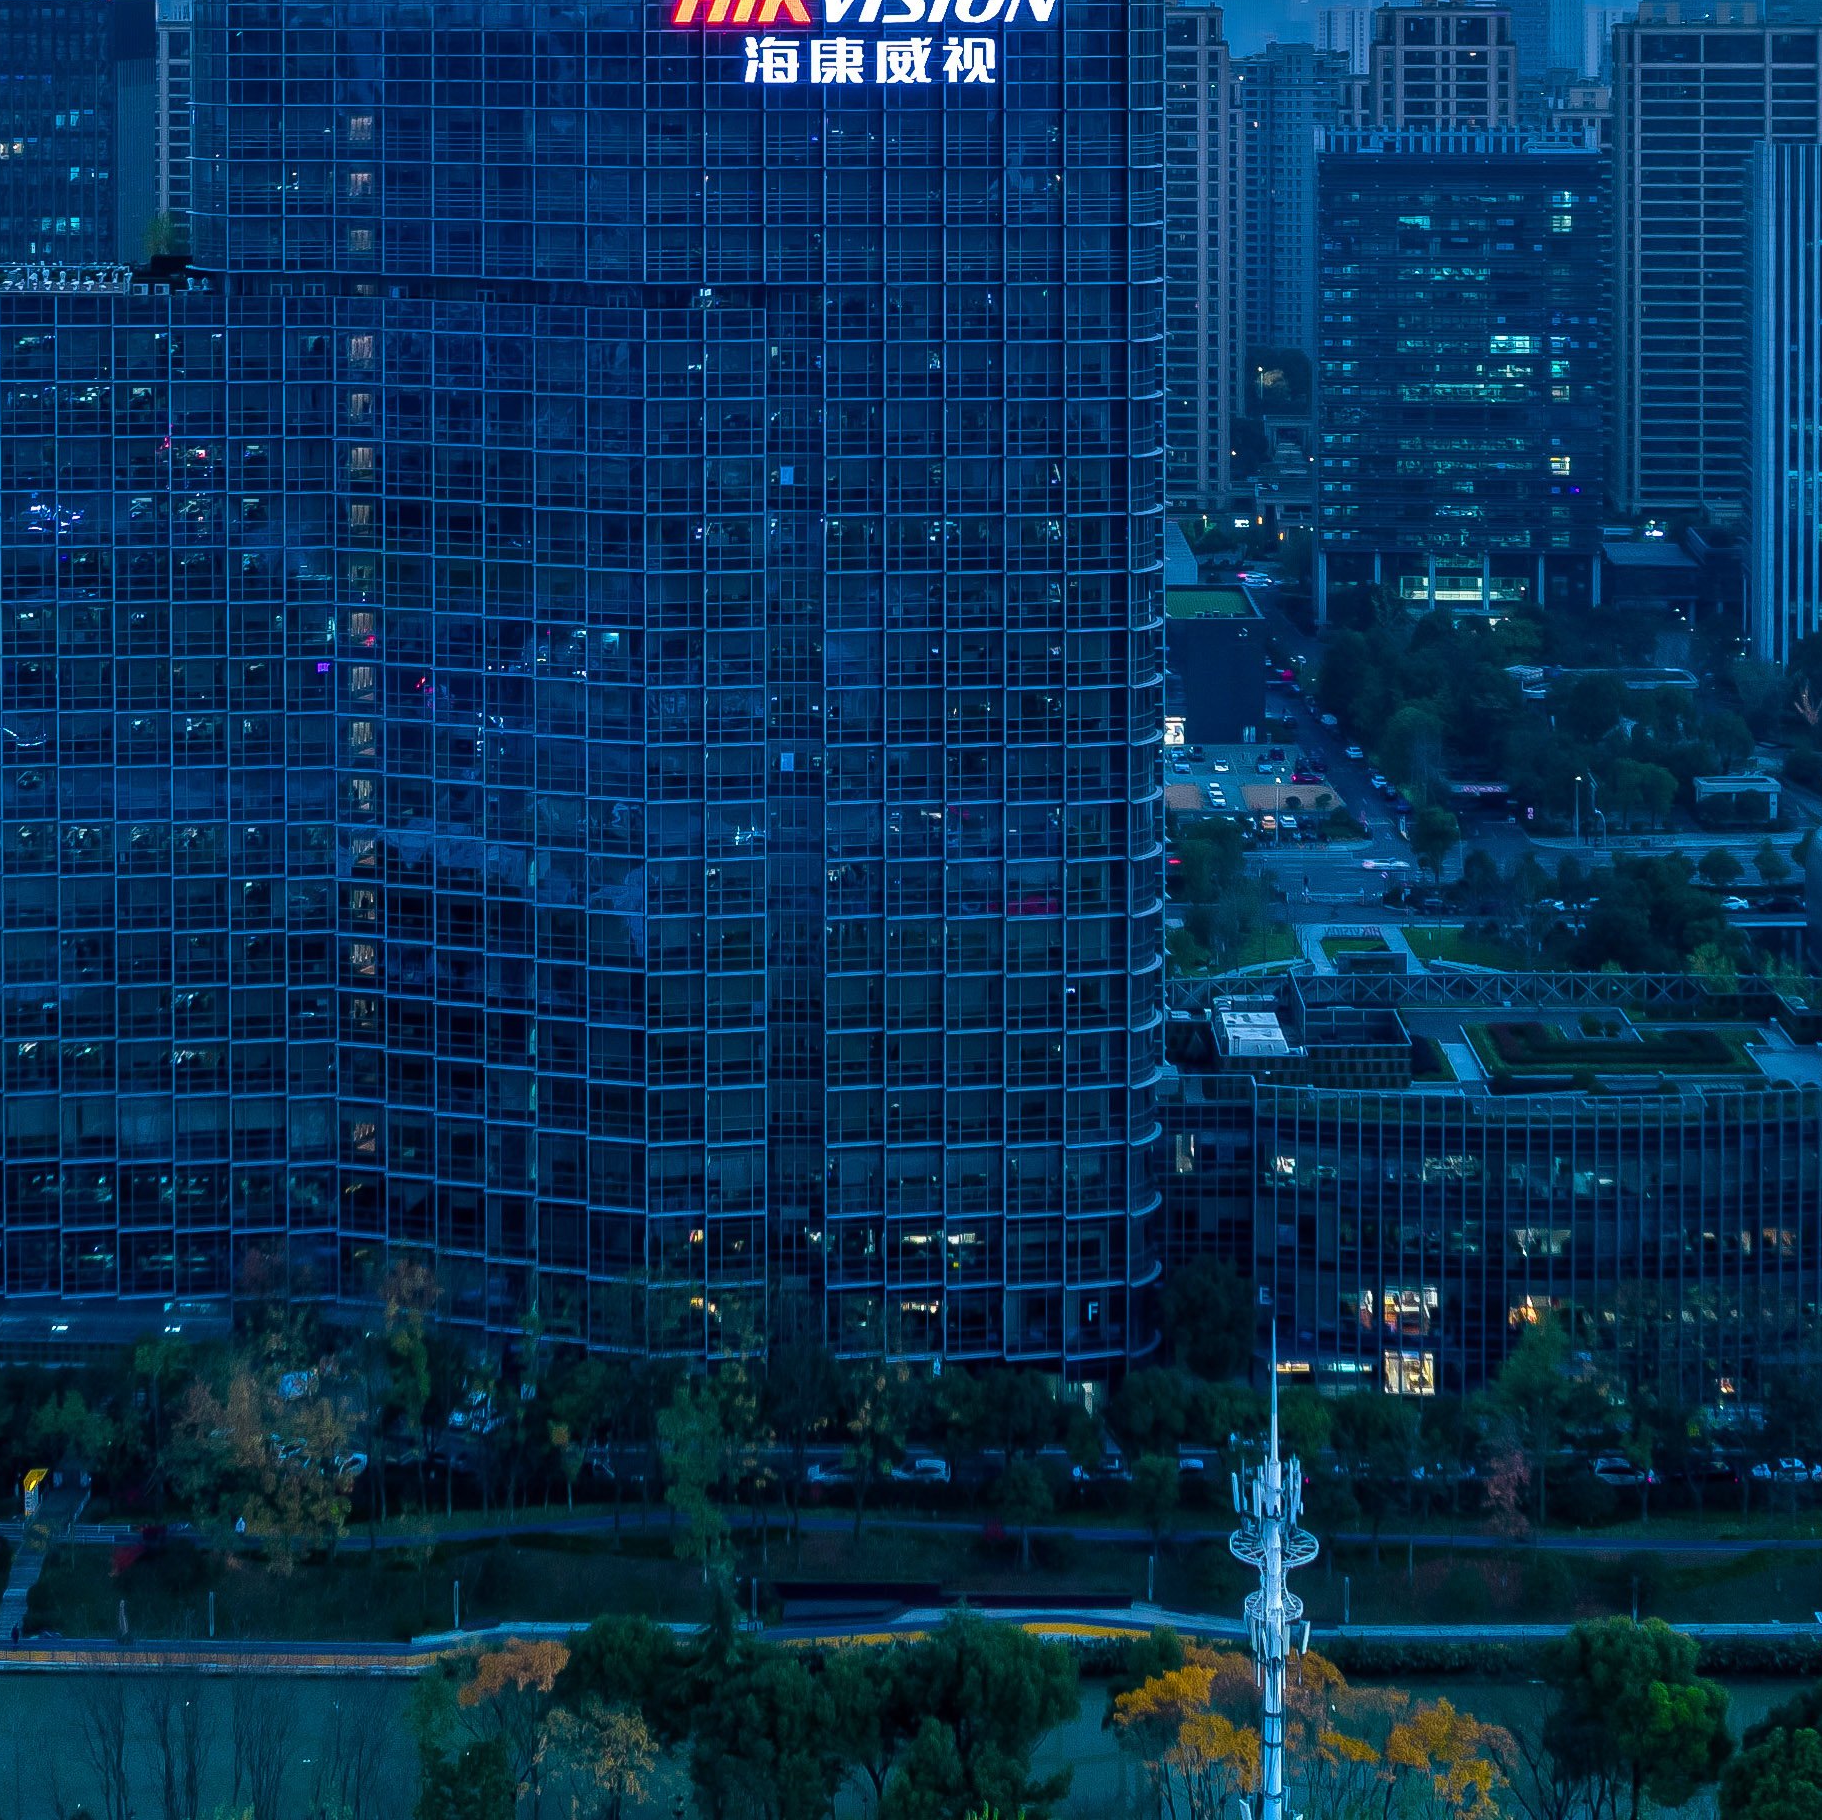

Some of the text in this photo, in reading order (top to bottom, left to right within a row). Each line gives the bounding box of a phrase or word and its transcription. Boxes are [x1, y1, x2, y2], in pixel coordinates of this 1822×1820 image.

[743, 36, 997, 84] 海康威视
[1259, 1286, 1273, 1305] E
[1088, 1302, 1099, 1322] F
